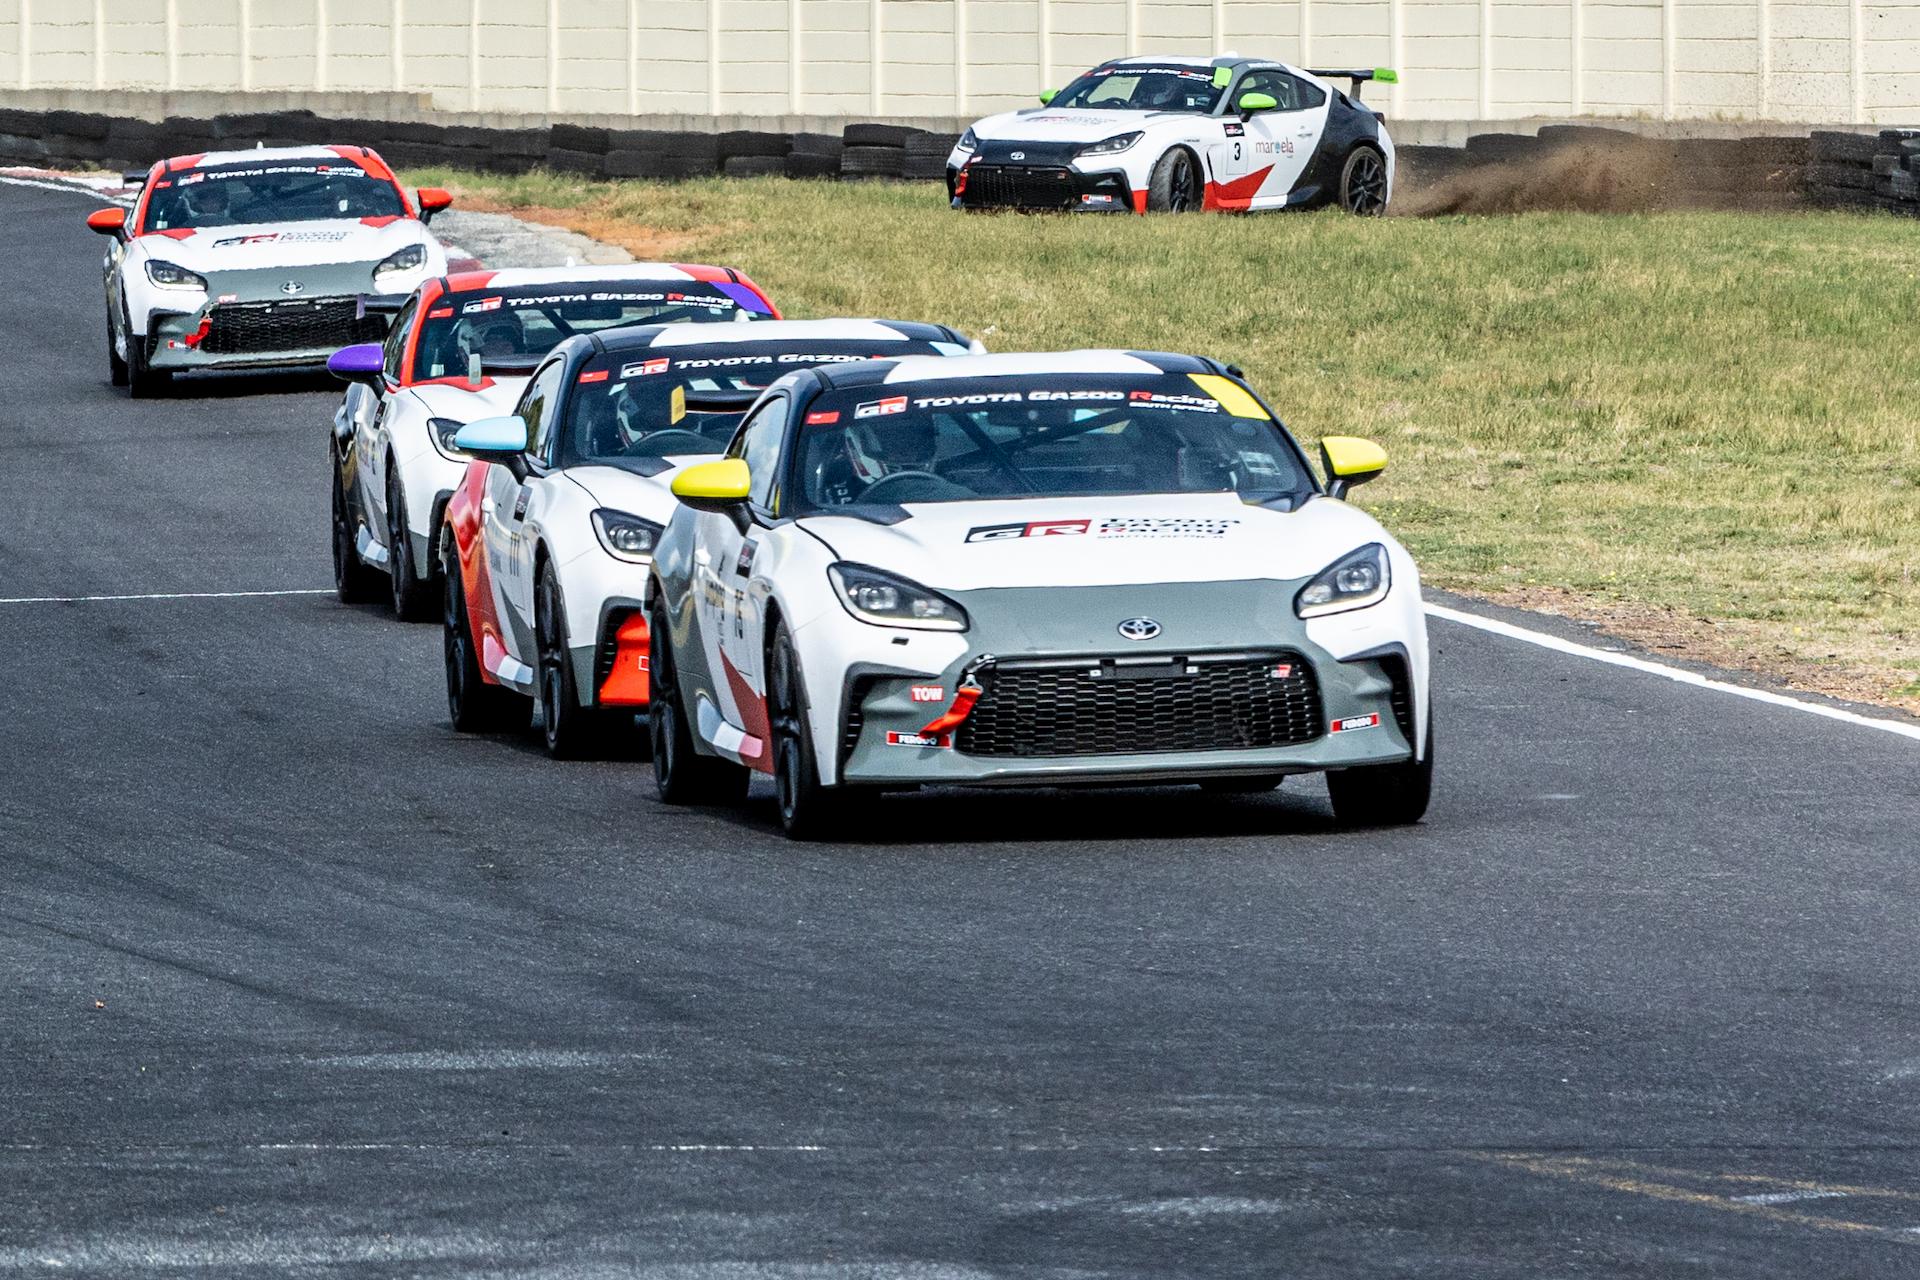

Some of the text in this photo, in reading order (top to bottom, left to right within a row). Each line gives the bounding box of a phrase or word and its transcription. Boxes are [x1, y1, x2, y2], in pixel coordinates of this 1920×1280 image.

[1234, 142, 1241, 161] 3
[208, 168, 264, 180] TOYOTA
[462, 291, 735, 315] GR TOYOTA GAZOO Racing
[620, 357, 670, 380] GR
[674, 355, 774, 370] TOYOTA
[854, 390, 1219, 420] GR TOYOTA GAZOO Racing
[1129, 401, 1218, 414] SOUTH AFRICA
[963, 519, 1092, 544] GR
[912, 687, 943, 701] TOW
